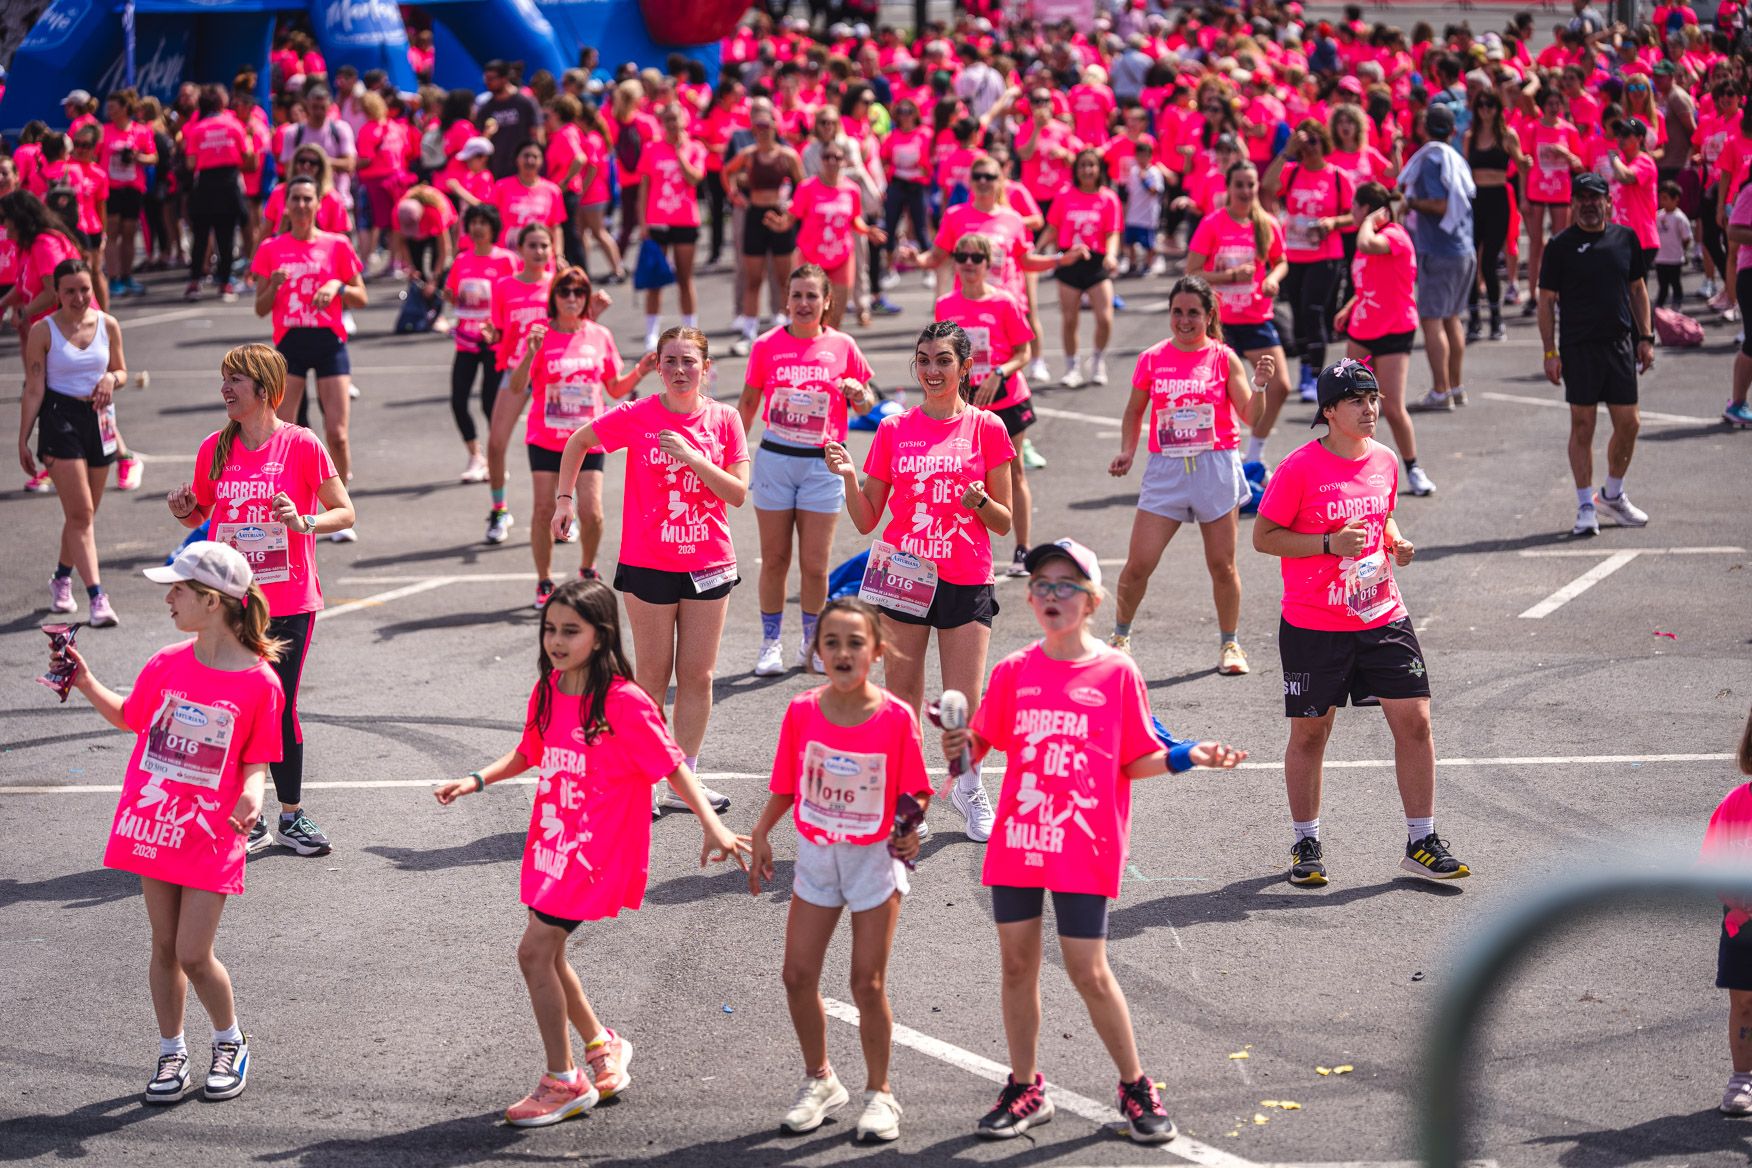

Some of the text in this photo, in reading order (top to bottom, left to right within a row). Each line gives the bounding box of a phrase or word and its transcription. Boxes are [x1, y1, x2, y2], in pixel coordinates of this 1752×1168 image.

[776, 365, 830, 381] CARRERA
[1154, 379, 1206, 395] CARRERA
[787, 412, 809, 424] 016
[899, 440, 926, 449] OYSHO
[898, 456, 963, 473] CARRERA
[217, 480, 275, 500] CARRERA
[932, 479, 952, 504] DE
[1319, 481, 1348, 493] OYSHO
[1327, 495, 1387, 521] CARRERA
[661, 524, 709, 543] MUJER
[678, 545, 696, 554] 2026
[901, 539, 952, 559] MUJER
[887, 575, 915, 590] 016
[1360, 585, 1377, 601] 016
[166, 734, 199, 754] 016
[145, 760, 168, 774] OYSHO
[822, 787, 855, 803] 016
[115, 811, 186, 849] MUJER
[1005, 821, 1066, 854] MUJER
[132, 843, 158, 860] 2026
